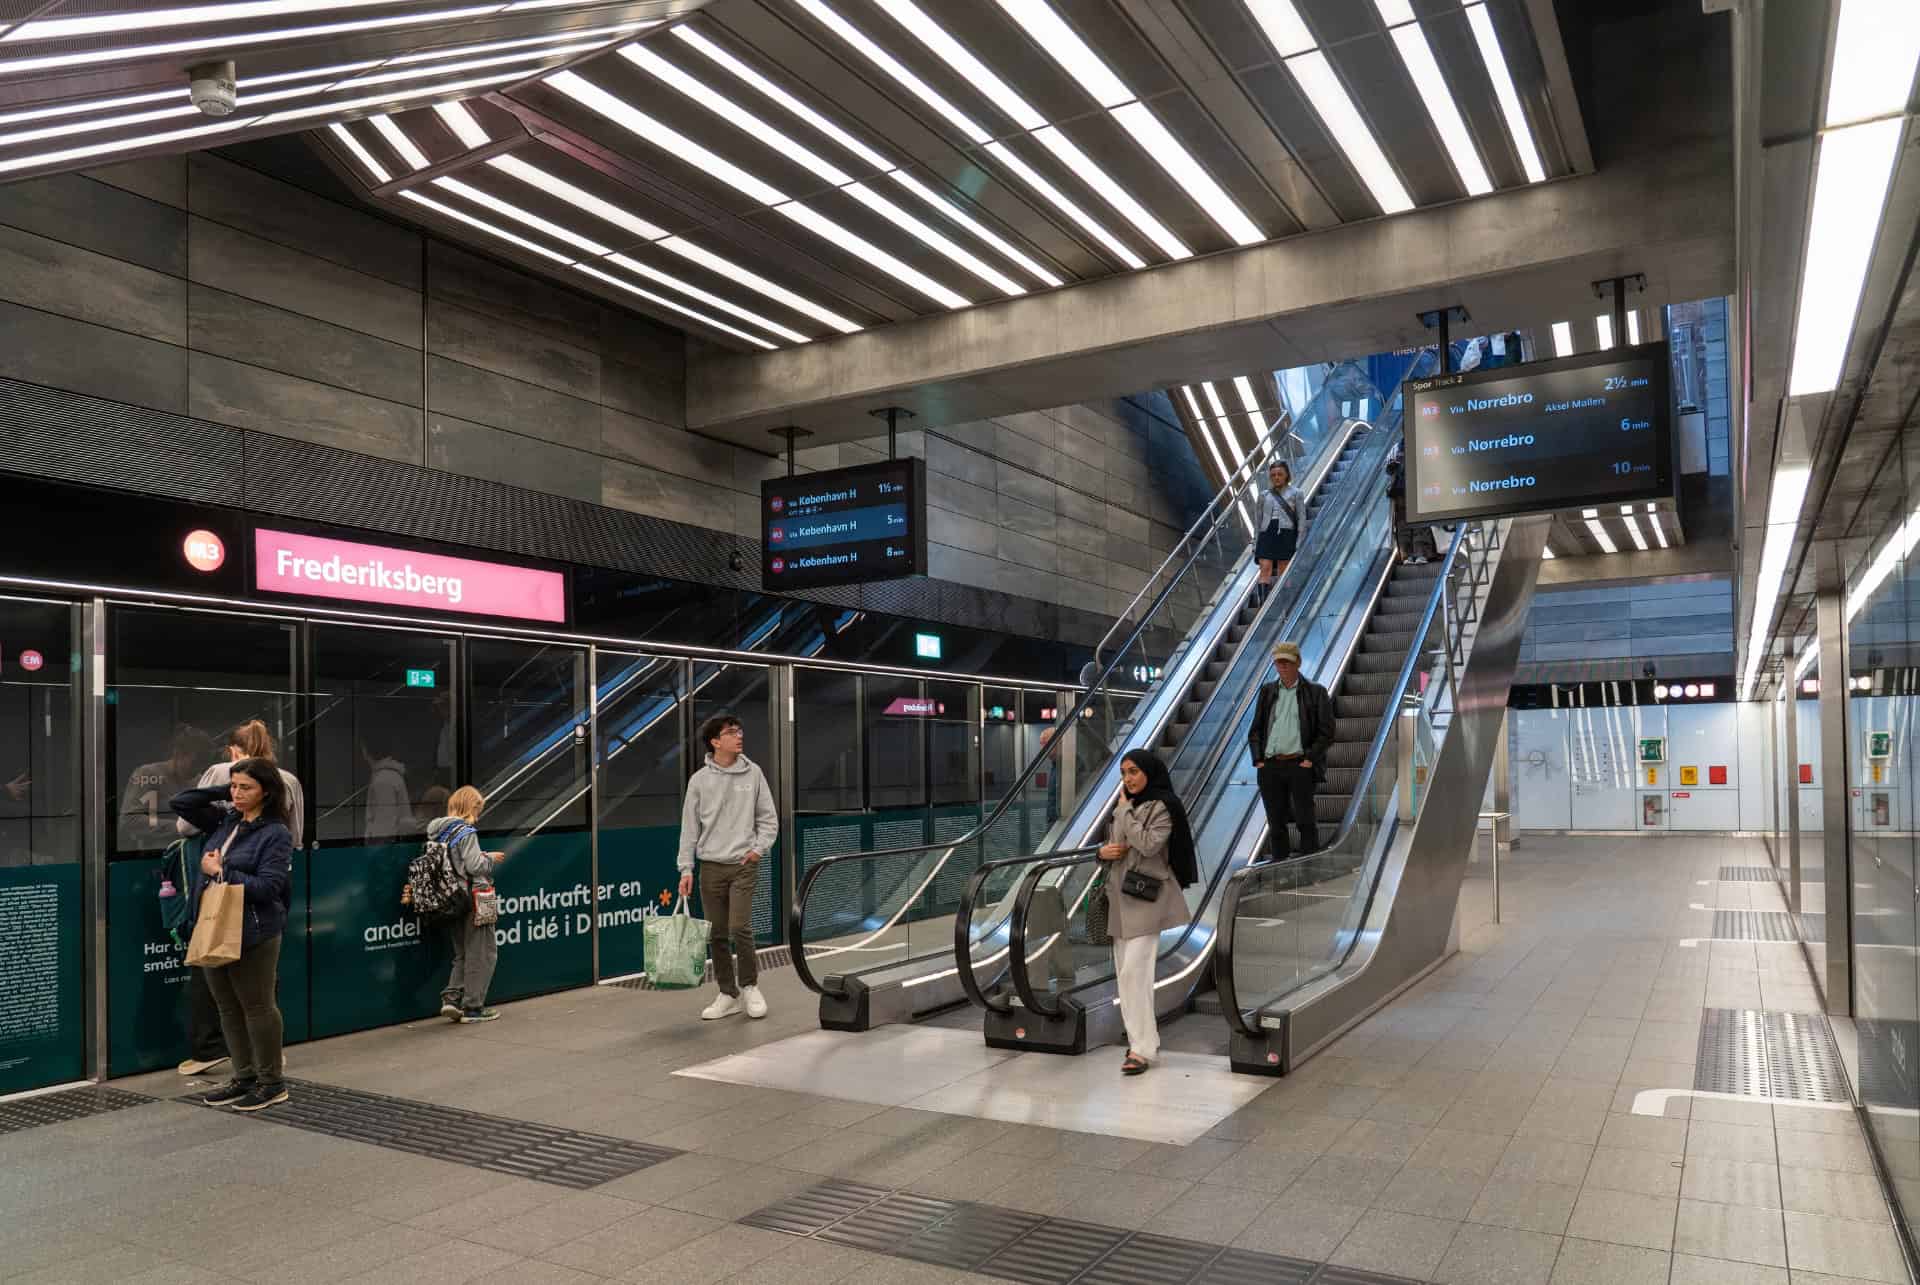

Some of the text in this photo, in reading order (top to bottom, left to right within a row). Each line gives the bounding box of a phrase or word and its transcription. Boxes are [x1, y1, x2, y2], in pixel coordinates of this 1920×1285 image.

[1467, 392, 1533, 412] Nørrebro
[1620, 418, 1631, 431] 6
[1468, 434, 1534, 452] Nørrebro
[1611, 461, 1631, 475] 10
[1469, 475, 1536, 493] Nørrebro
[799, 491, 848, 507] København
[849, 488, 857, 499] H
[887, 514, 893, 525] 5
[799, 523, 849, 538] København
[849, 520, 857, 530] H
[189, 542, 220, 560] M3
[799, 554, 849, 569] København
[850, 551, 858, 561] H
[276, 549, 462, 603] Frederiksberg
[496, 880, 641, 915] tomkraft er en
[364, 917, 421, 942] andel
[495, 920, 521, 946] od
[528, 915, 559, 942] idé
[564, 915, 570, 936] i
[144, 942, 171, 955] Har
[143, 956, 180, 972] småt
